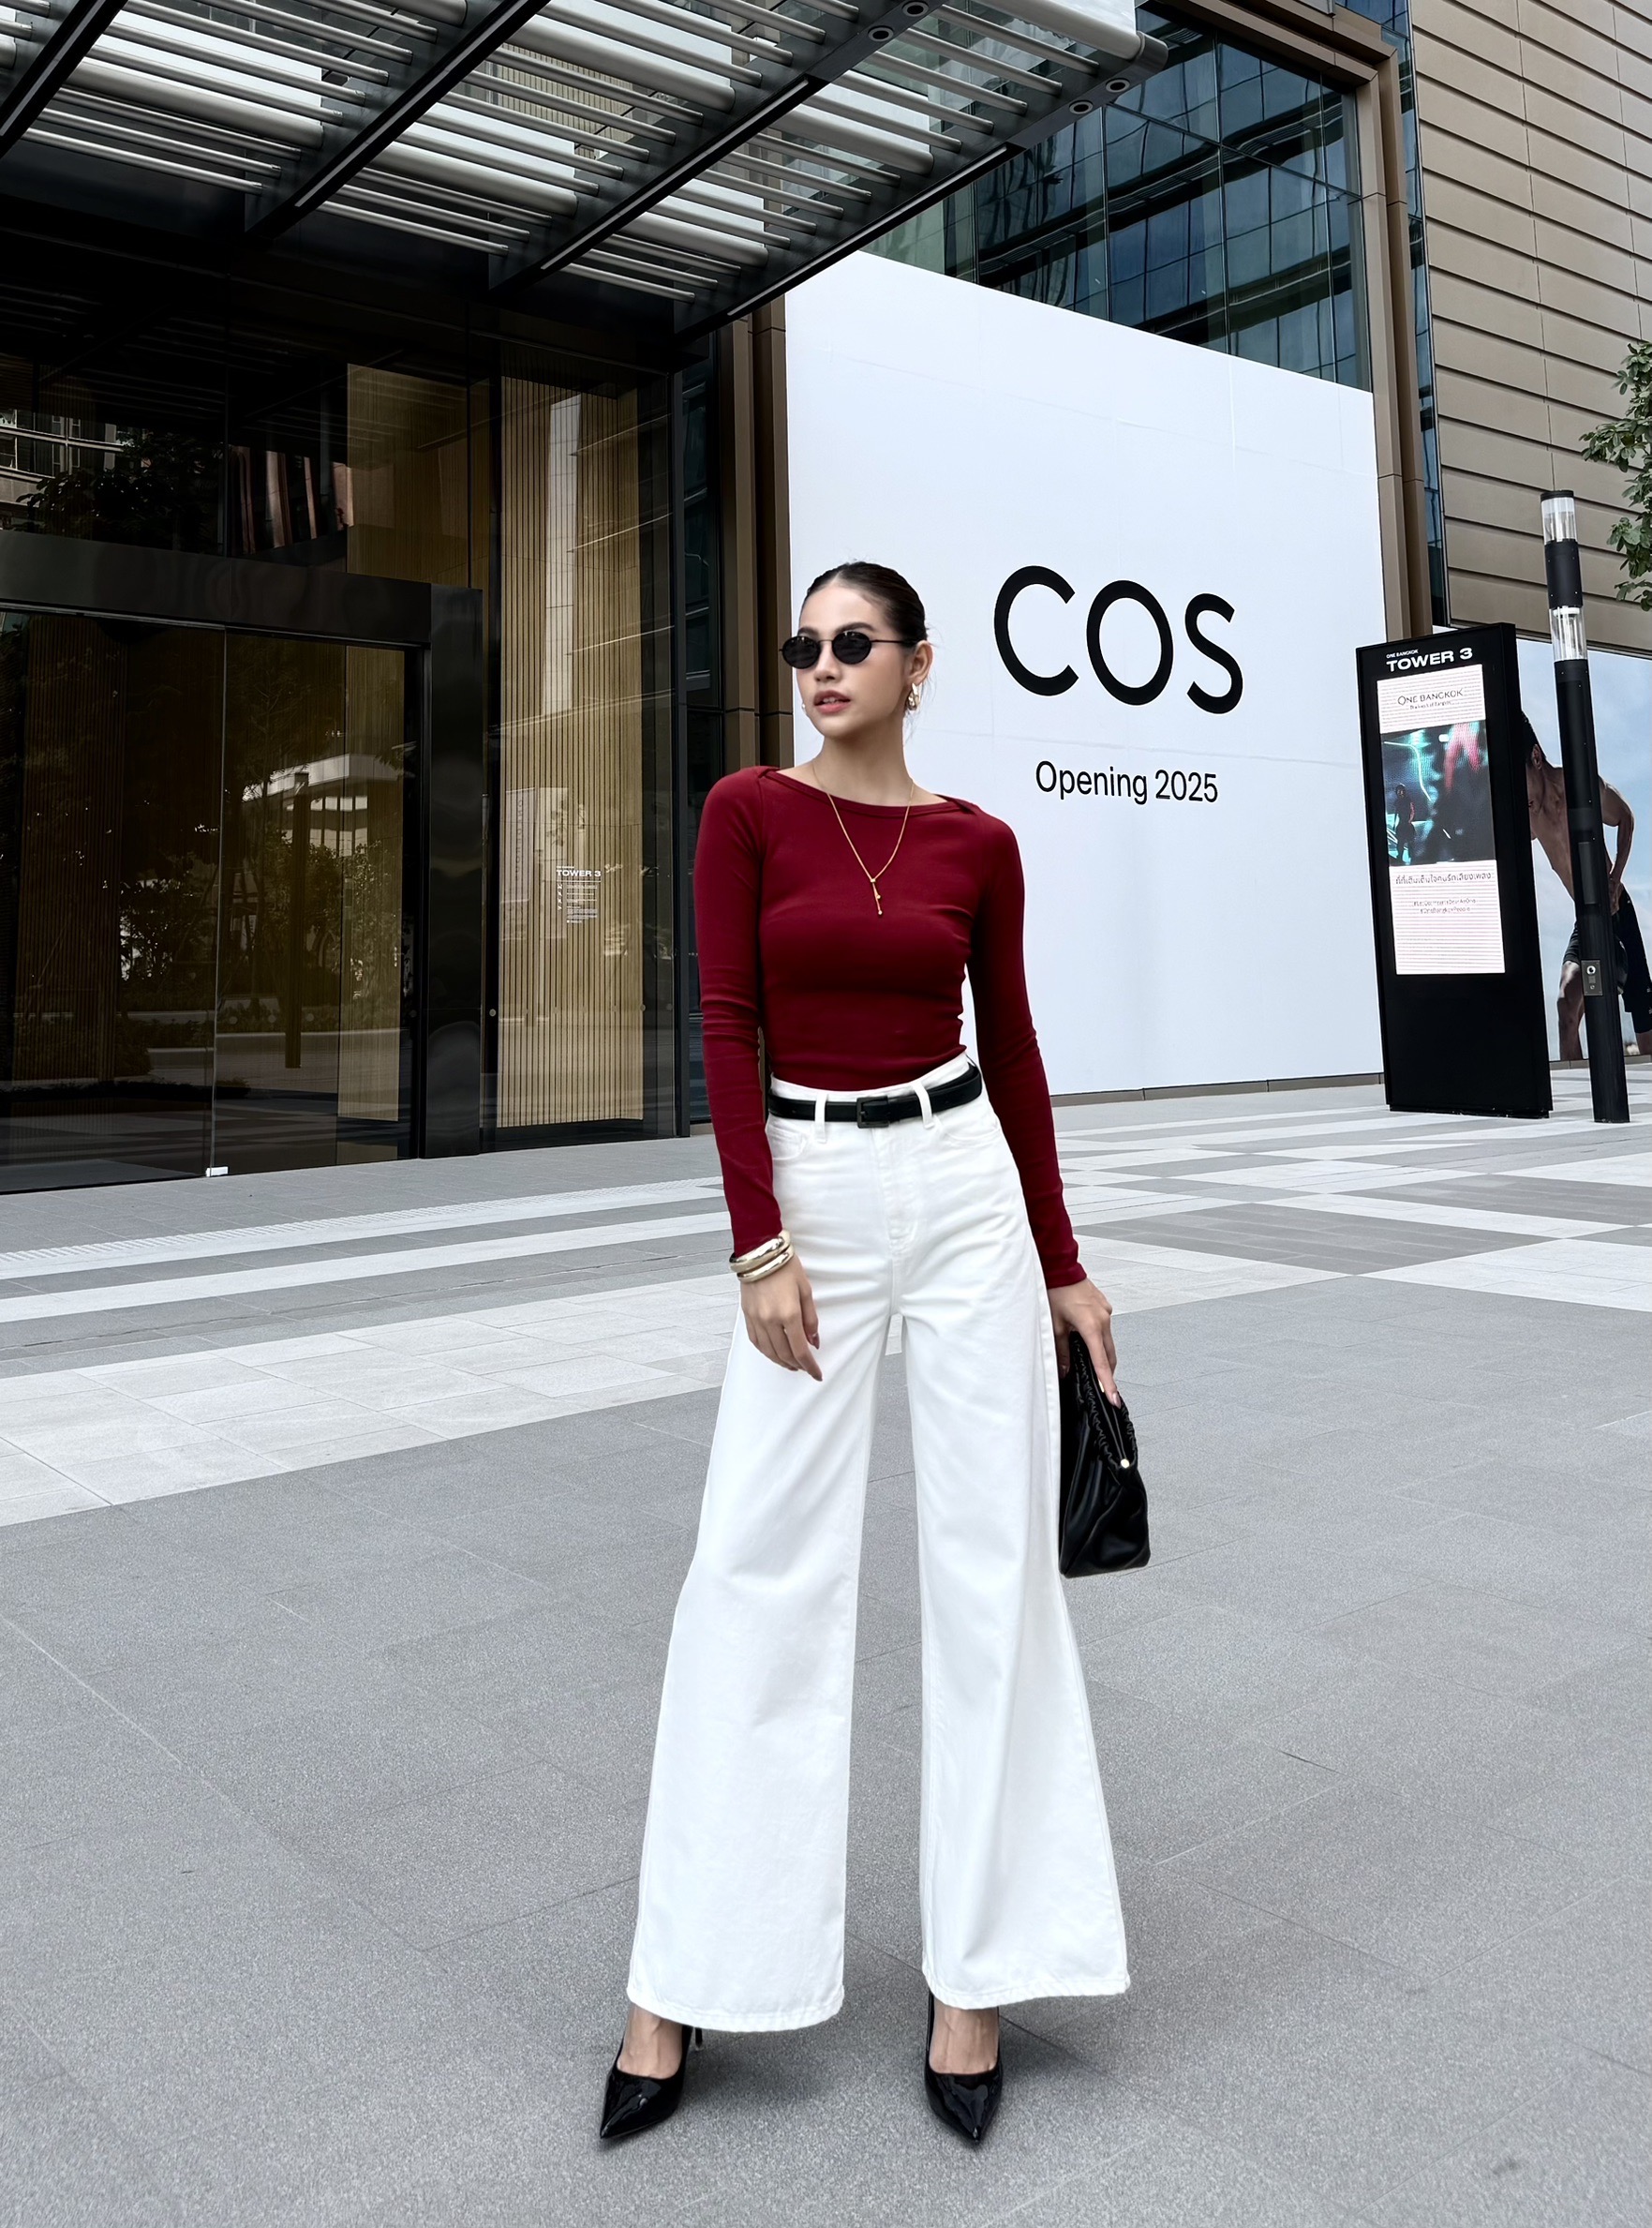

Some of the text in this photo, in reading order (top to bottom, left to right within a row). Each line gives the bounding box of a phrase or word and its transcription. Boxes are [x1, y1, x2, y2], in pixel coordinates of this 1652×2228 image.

[994, 565, 1243, 714] COS
[1386, 648, 1473, 672] TOWER 3
[1036, 761, 1219, 805] Opening 2025
